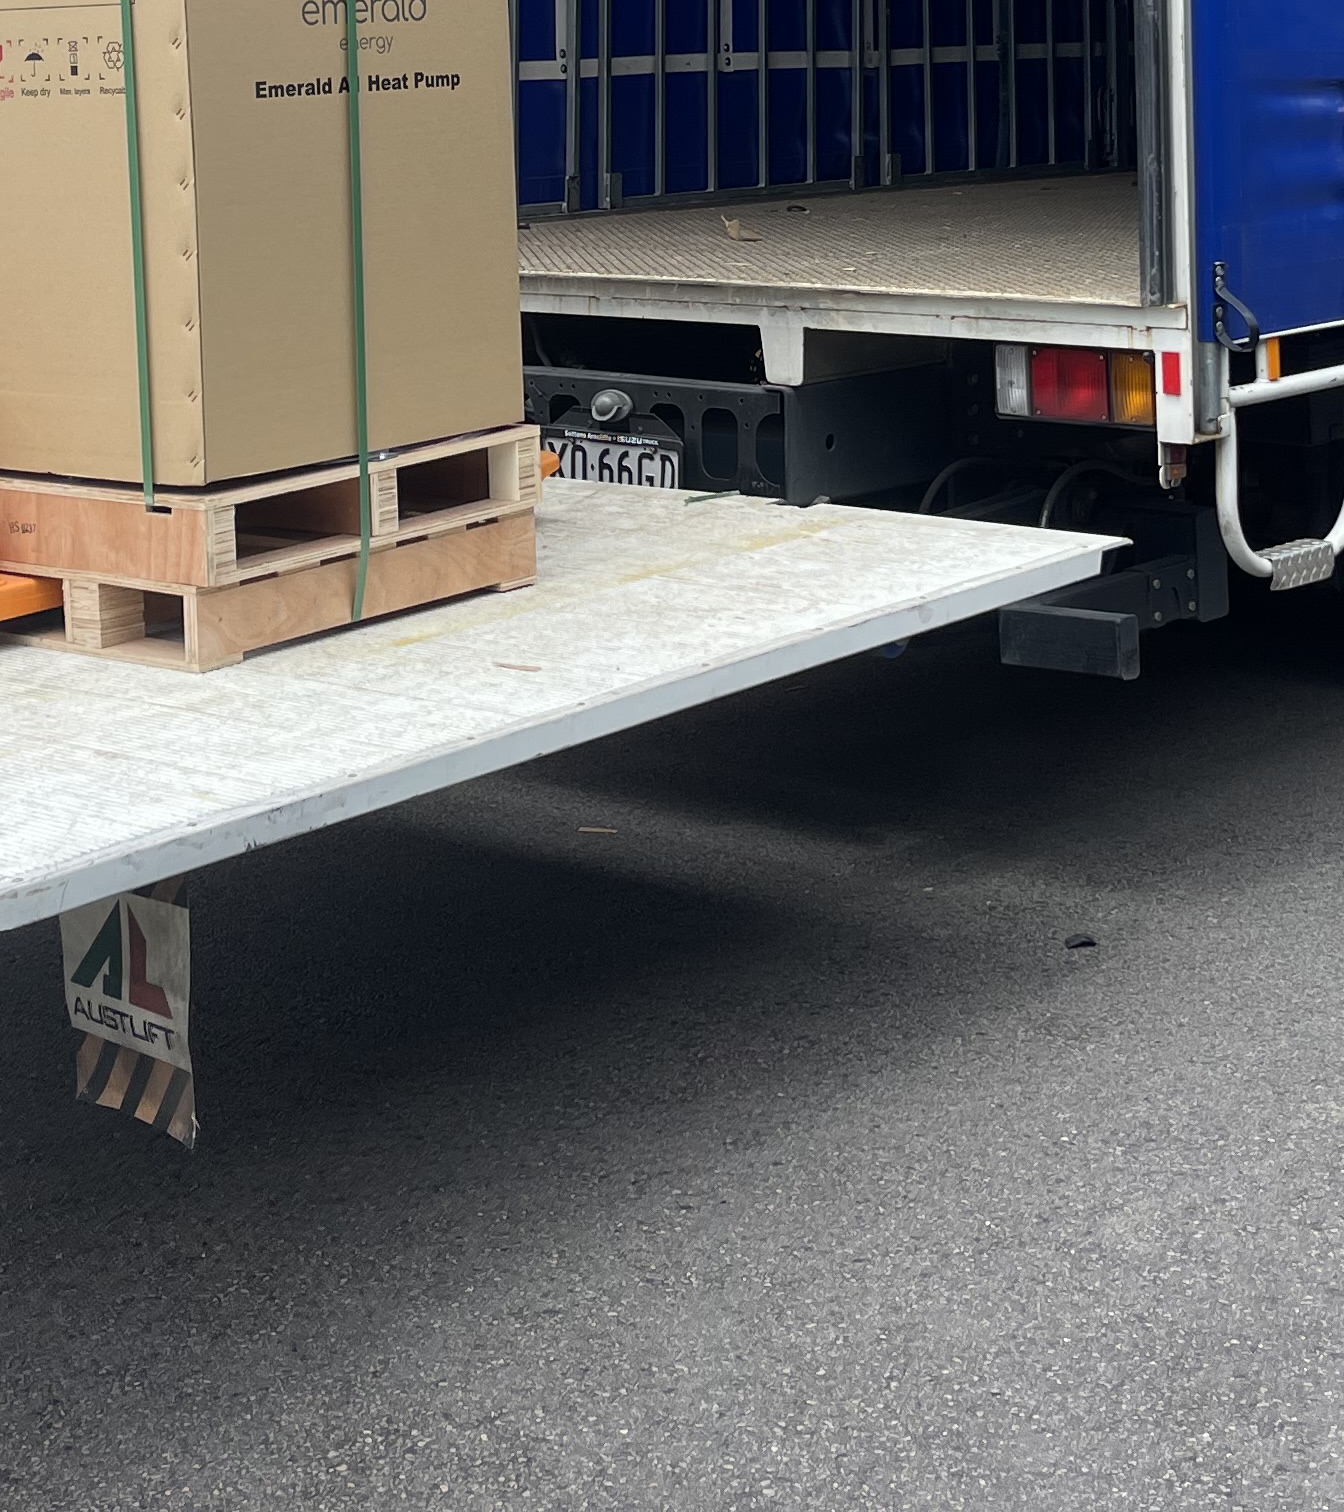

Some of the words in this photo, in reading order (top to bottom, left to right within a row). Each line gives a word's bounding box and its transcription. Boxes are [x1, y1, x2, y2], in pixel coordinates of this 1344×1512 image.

[339, 35, 393, 55] eergy
[21, 88, 40, 97] Keep
[40, 87, 51, 97] dry
[255, 77, 333, 99] Emerald
[367, 73, 409, 91] Heat
[414, 72, 461, 90] Pump
[74, 996, 175, 1051] AUSTLIFT
